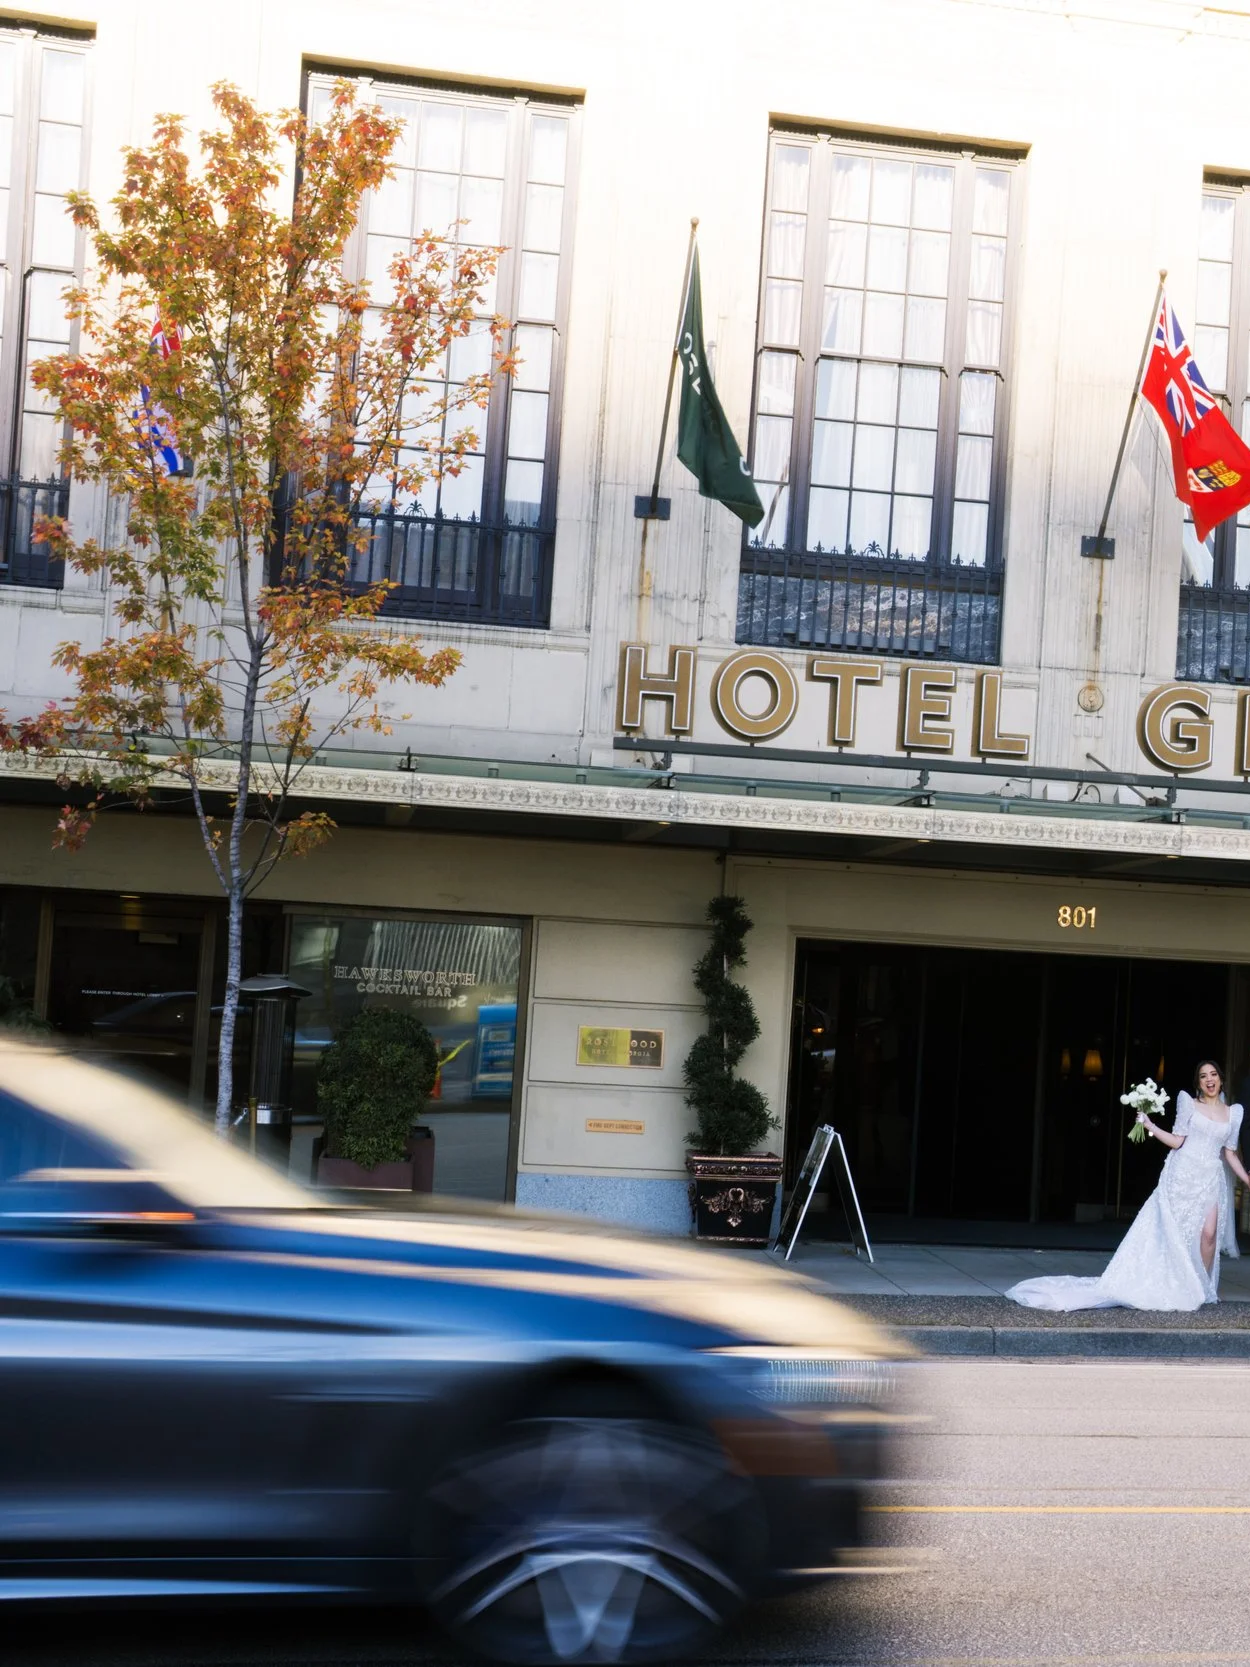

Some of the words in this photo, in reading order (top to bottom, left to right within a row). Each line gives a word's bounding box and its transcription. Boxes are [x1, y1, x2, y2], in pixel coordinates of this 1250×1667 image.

[616, 641, 1030, 760] HOTEL
[1057, 905, 1096, 928] 801
[334, 966, 476, 986] HAWKSWORTH
[357, 982, 421, 996] COCKTAIL
[427, 986, 452, 997] BAR
